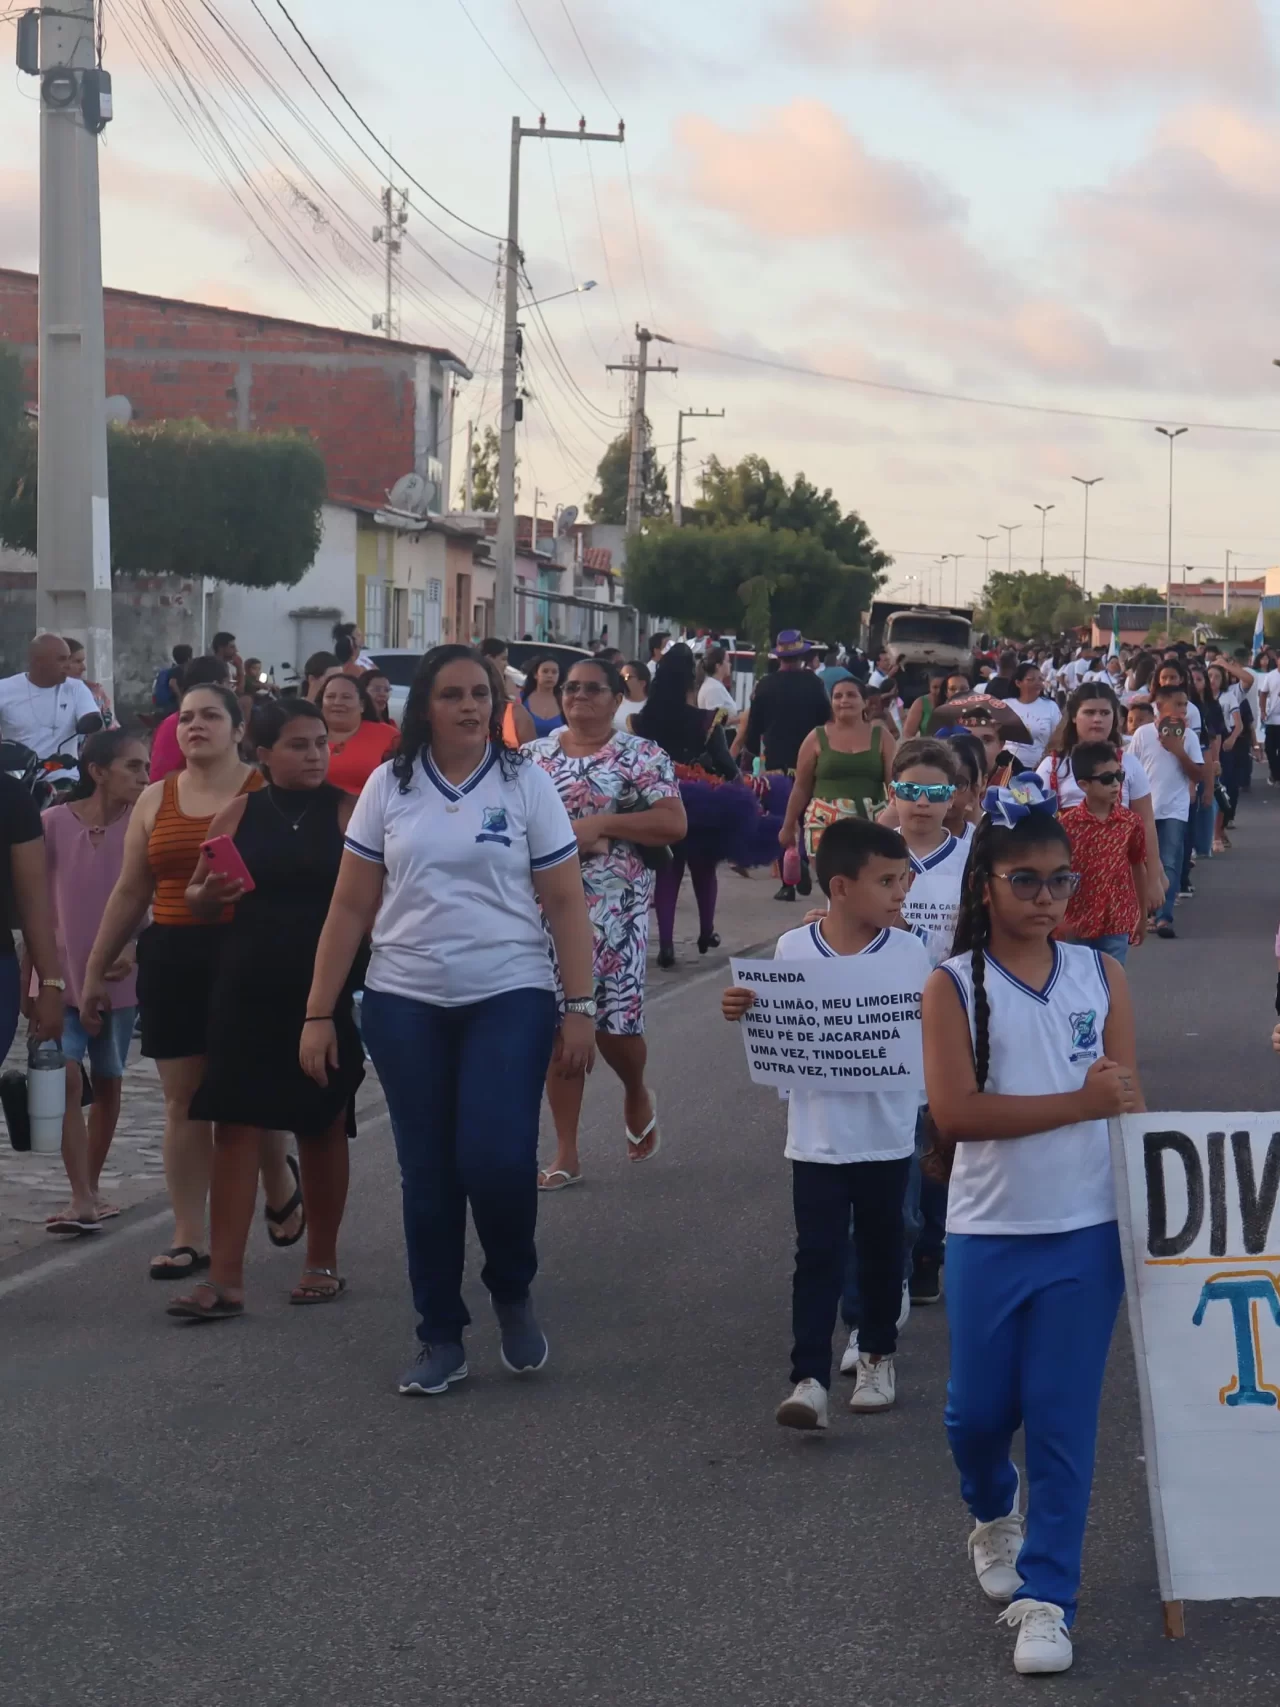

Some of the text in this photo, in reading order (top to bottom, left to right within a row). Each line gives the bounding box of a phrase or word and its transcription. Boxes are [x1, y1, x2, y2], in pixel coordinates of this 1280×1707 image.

[738, 971, 806, 983] PARLENDA
[753, 992, 922, 1011] EU LIMÃO, MEU LIMOEIRO
[745, 1012, 772, 1023] MEU
[775, 1014, 820, 1028] LIMÃO,
[824, 1015, 853, 1026] MEU
[748, 1027, 900, 1042] MEU PÉ DE JACARANDÁ
[751, 1044, 887, 1060] UMA VEZ, TINDOLELÊ
[754, 1061, 910, 1078] OUTRA VEZ, TINDOLALÁ.
